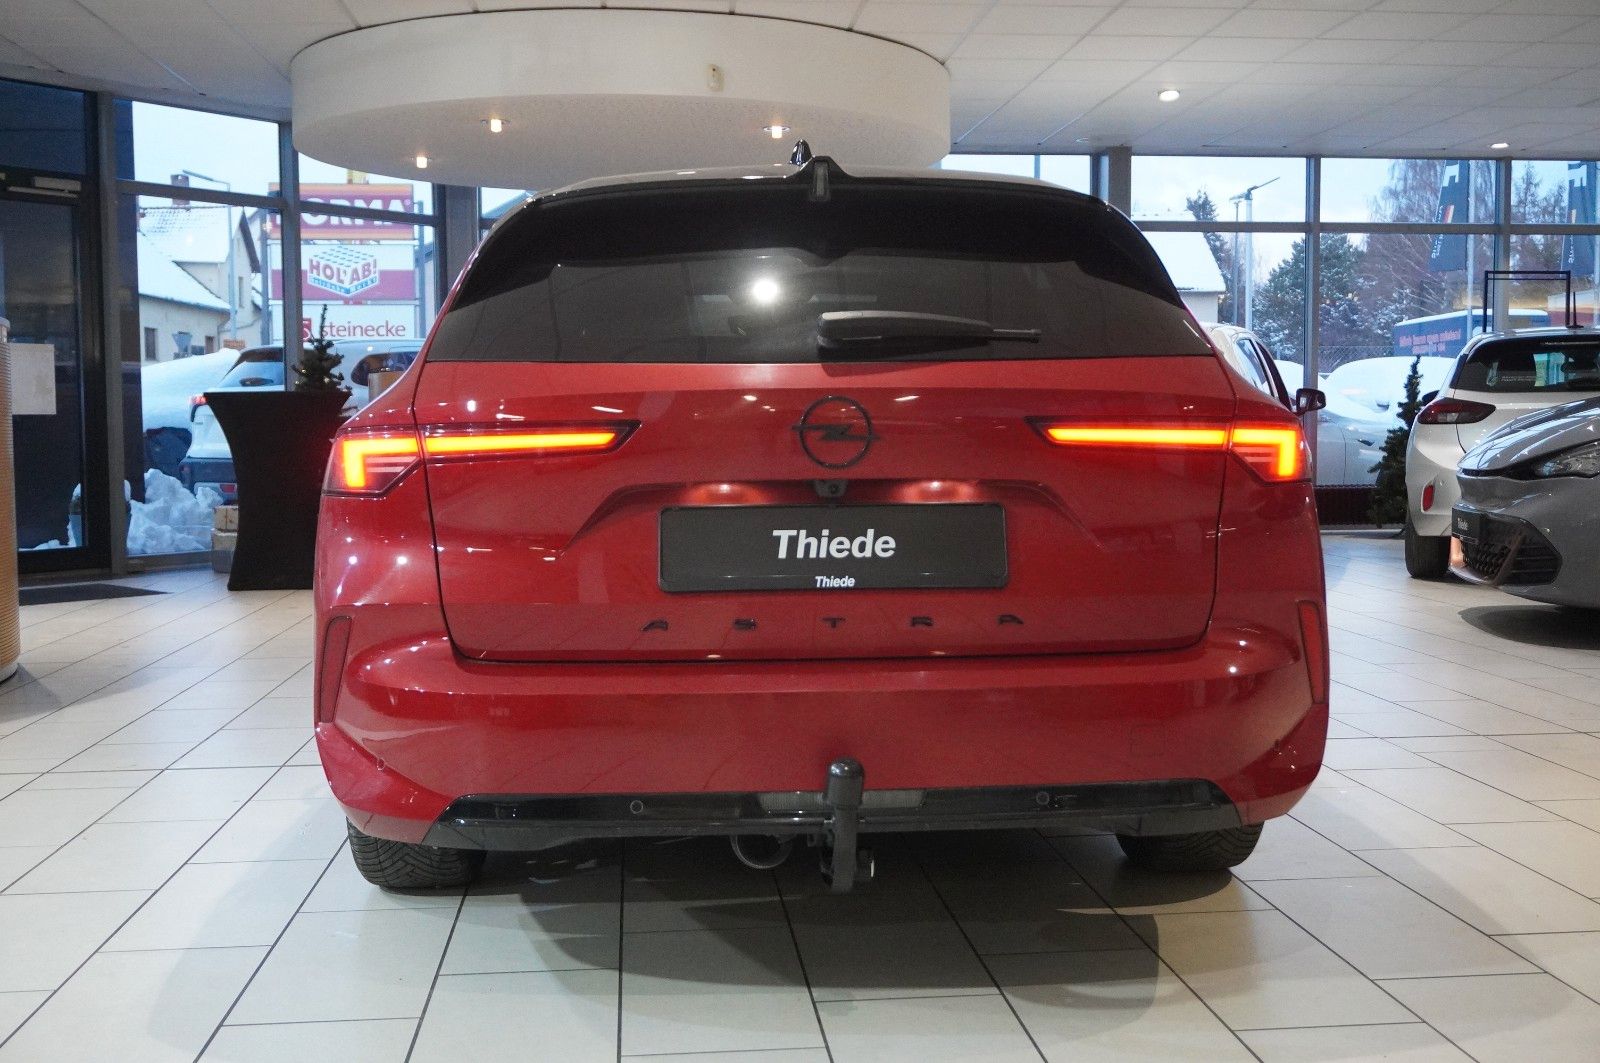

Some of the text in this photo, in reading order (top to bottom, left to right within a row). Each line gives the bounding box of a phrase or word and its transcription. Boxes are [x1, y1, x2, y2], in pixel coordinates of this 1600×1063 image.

[321, 320, 406, 338] steinecke
[772, 528, 897, 559] Thiede
[814, 575, 856, 588] Thiede
